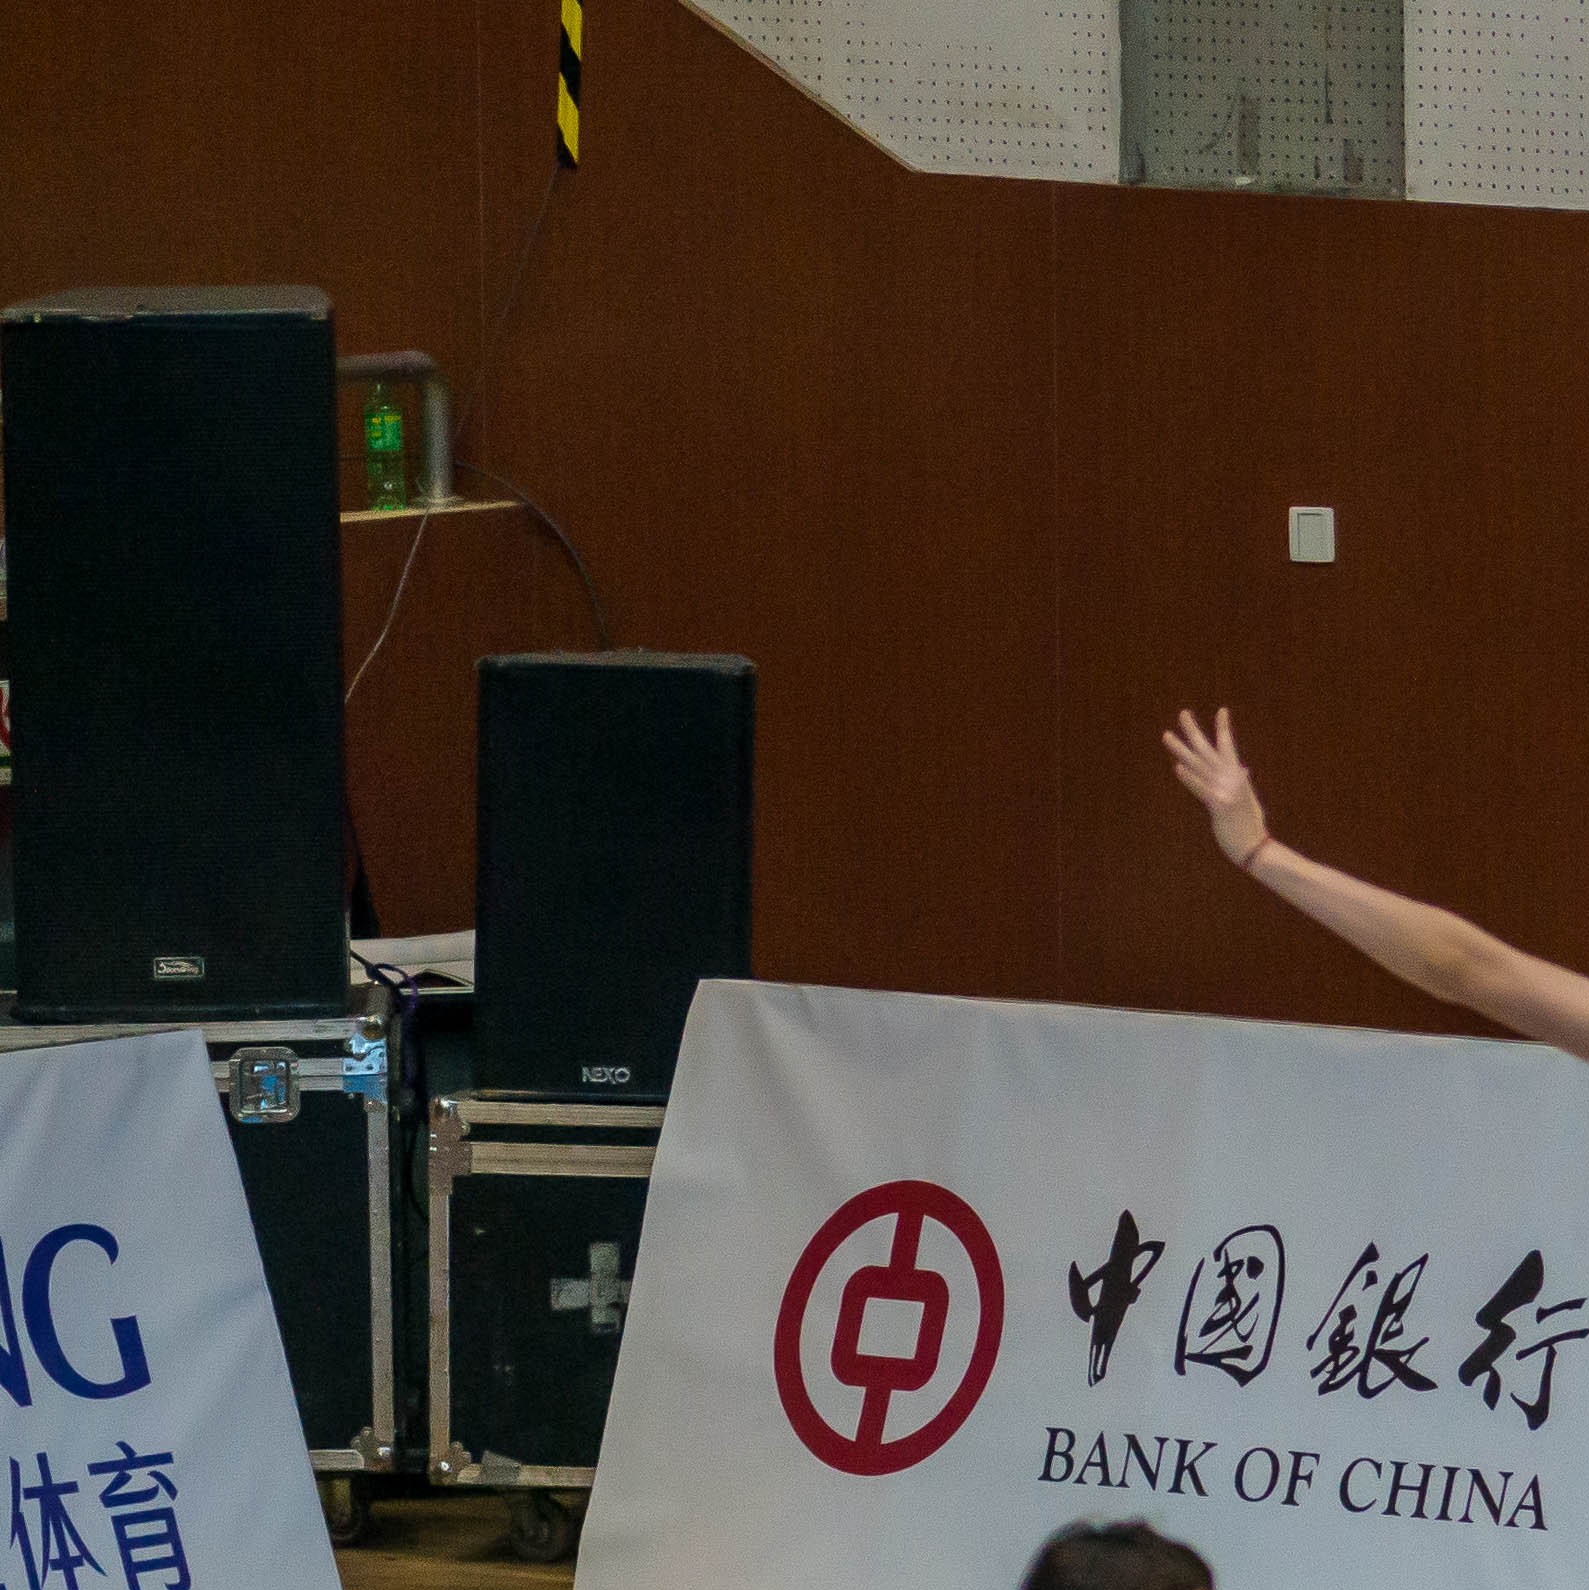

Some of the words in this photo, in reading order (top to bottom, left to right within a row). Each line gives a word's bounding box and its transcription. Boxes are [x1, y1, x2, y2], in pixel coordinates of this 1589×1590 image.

[582, 1066, 631, 1085] NEXO
[1038, 1427, 1217, 1497] BANK
[1235, 1447, 1320, 1507] OF
[1339, 1457, 1548, 1531] CHINA
